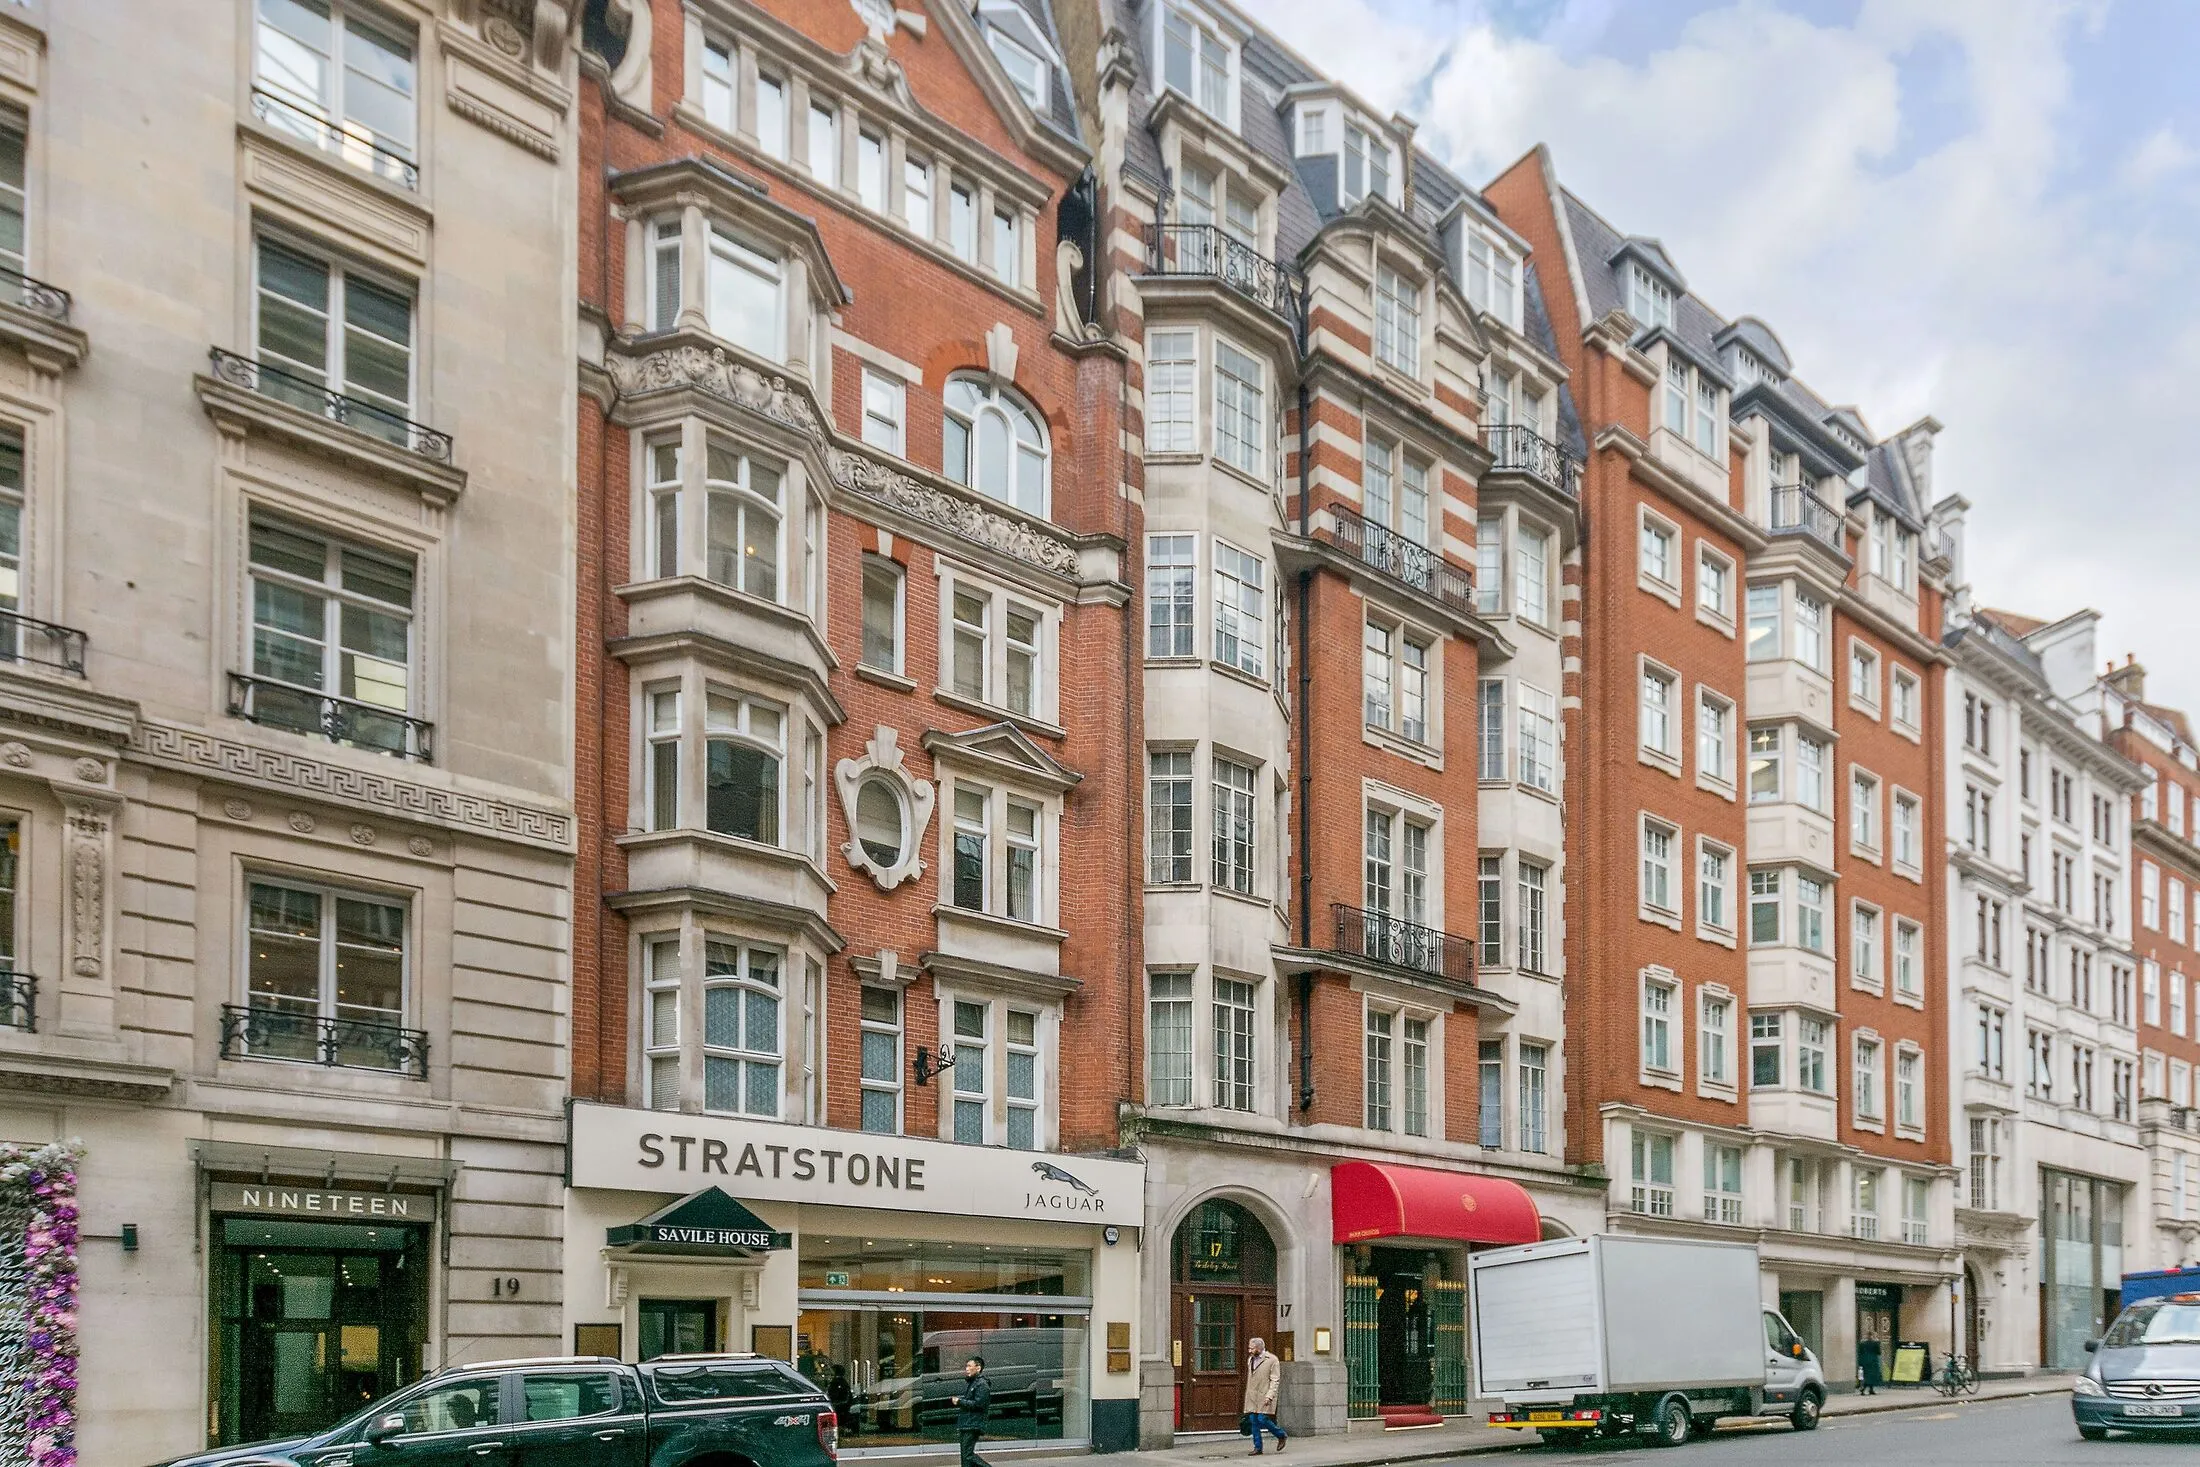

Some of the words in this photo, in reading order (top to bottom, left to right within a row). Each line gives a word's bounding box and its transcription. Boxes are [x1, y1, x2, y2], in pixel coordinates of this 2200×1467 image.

[638, 1133, 925, 1191] STRATSTONE
[242, 1189, 408, 1216] NINETEEN
[1024, 1193, 1105, 1213] JAGUAR
[658, 1228, 716, 1244] SAVILE
[718, 1231, 770, 1246] HOUSE
[1210, 1242, 1222, 1257] 17
[494, 1277, 520, 1296] 19
[1280, 1304, 1292, 1318] 17
